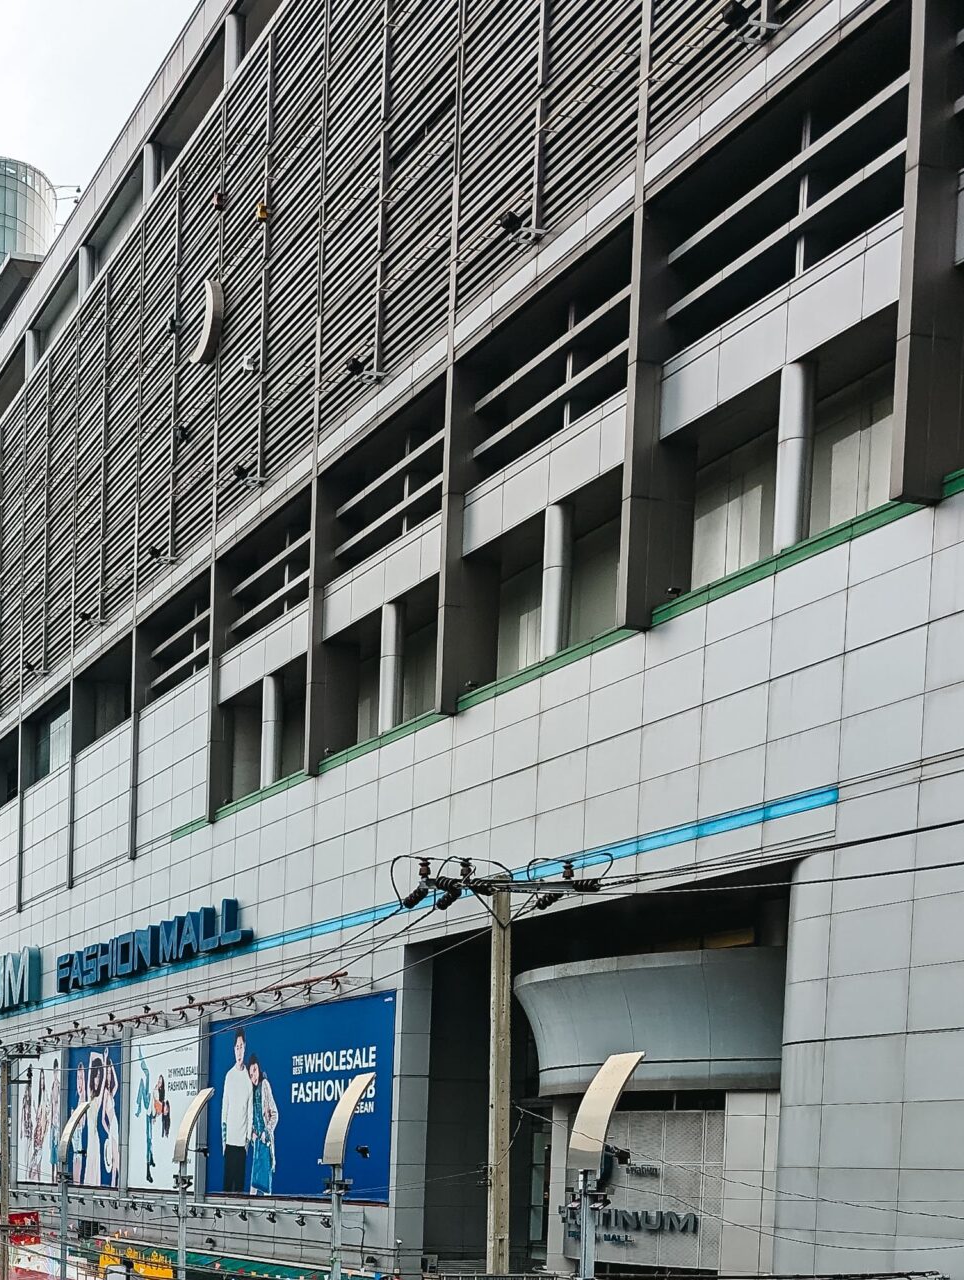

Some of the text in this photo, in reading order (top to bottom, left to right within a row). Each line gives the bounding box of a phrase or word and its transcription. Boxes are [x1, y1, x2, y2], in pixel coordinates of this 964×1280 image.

[56, 897, 254, 993] FASHION MALL
[292, 1046, 377, 1073] THE WHOLESALE
[292, 1066, 304, 1075] BEST
[167, 1080, 188, 1092] FASHION
[291, 1079, 345, 1104] FASHION
[354, 1101, 374, 1114] SEAN
